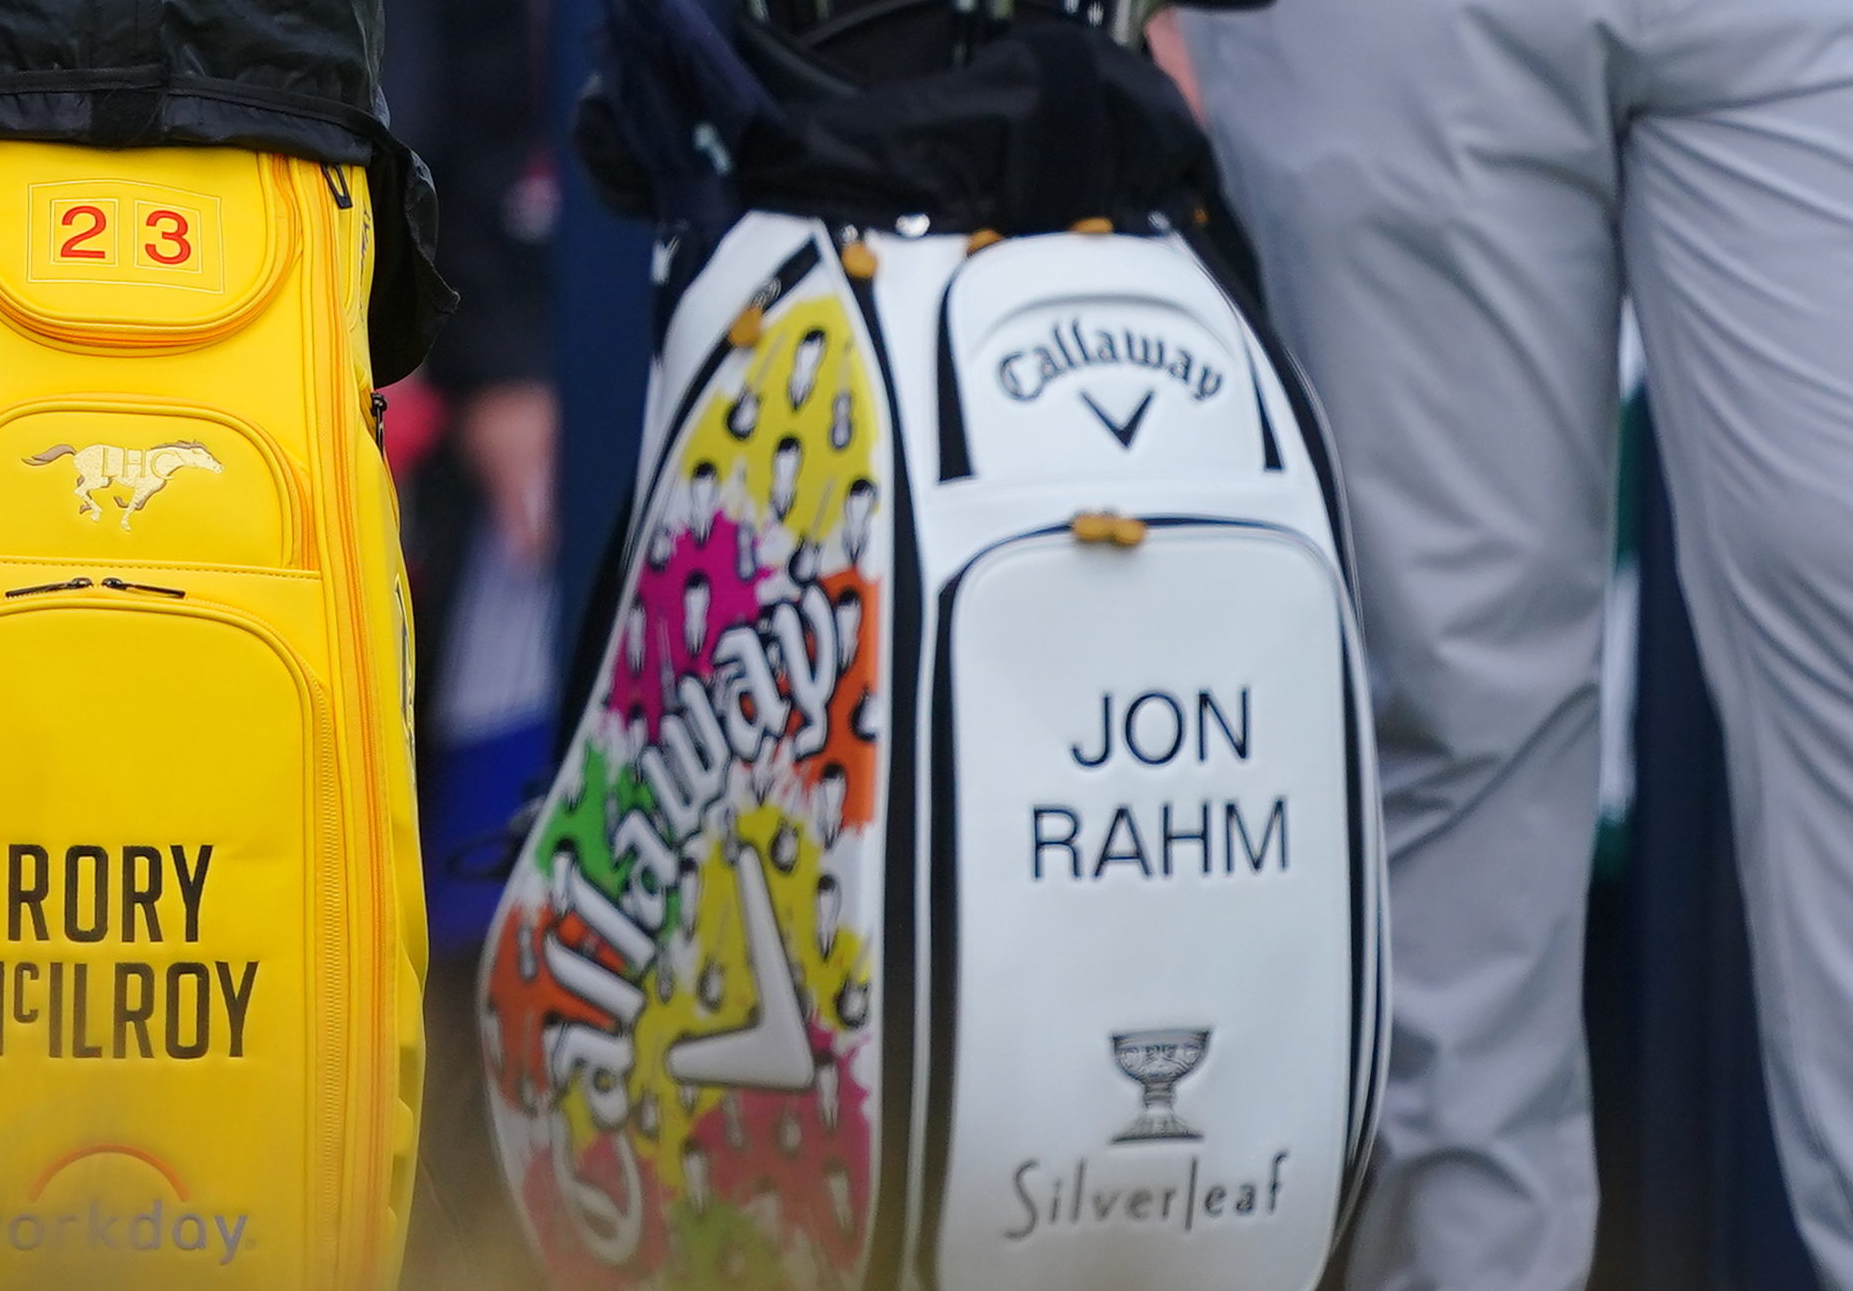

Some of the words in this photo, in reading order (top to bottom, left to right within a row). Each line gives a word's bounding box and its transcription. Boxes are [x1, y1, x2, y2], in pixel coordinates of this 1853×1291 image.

[996, 319, 1225, 404] Callaway
[1071, 687, 1252, 767] JON
[1031, 799, 1290, 879] RAHM
[8, 843, 214, 944] RORY
[543, 601, 840, 1268] Callaway
[1005, 1151, 1292, 1243] Silverleaf
